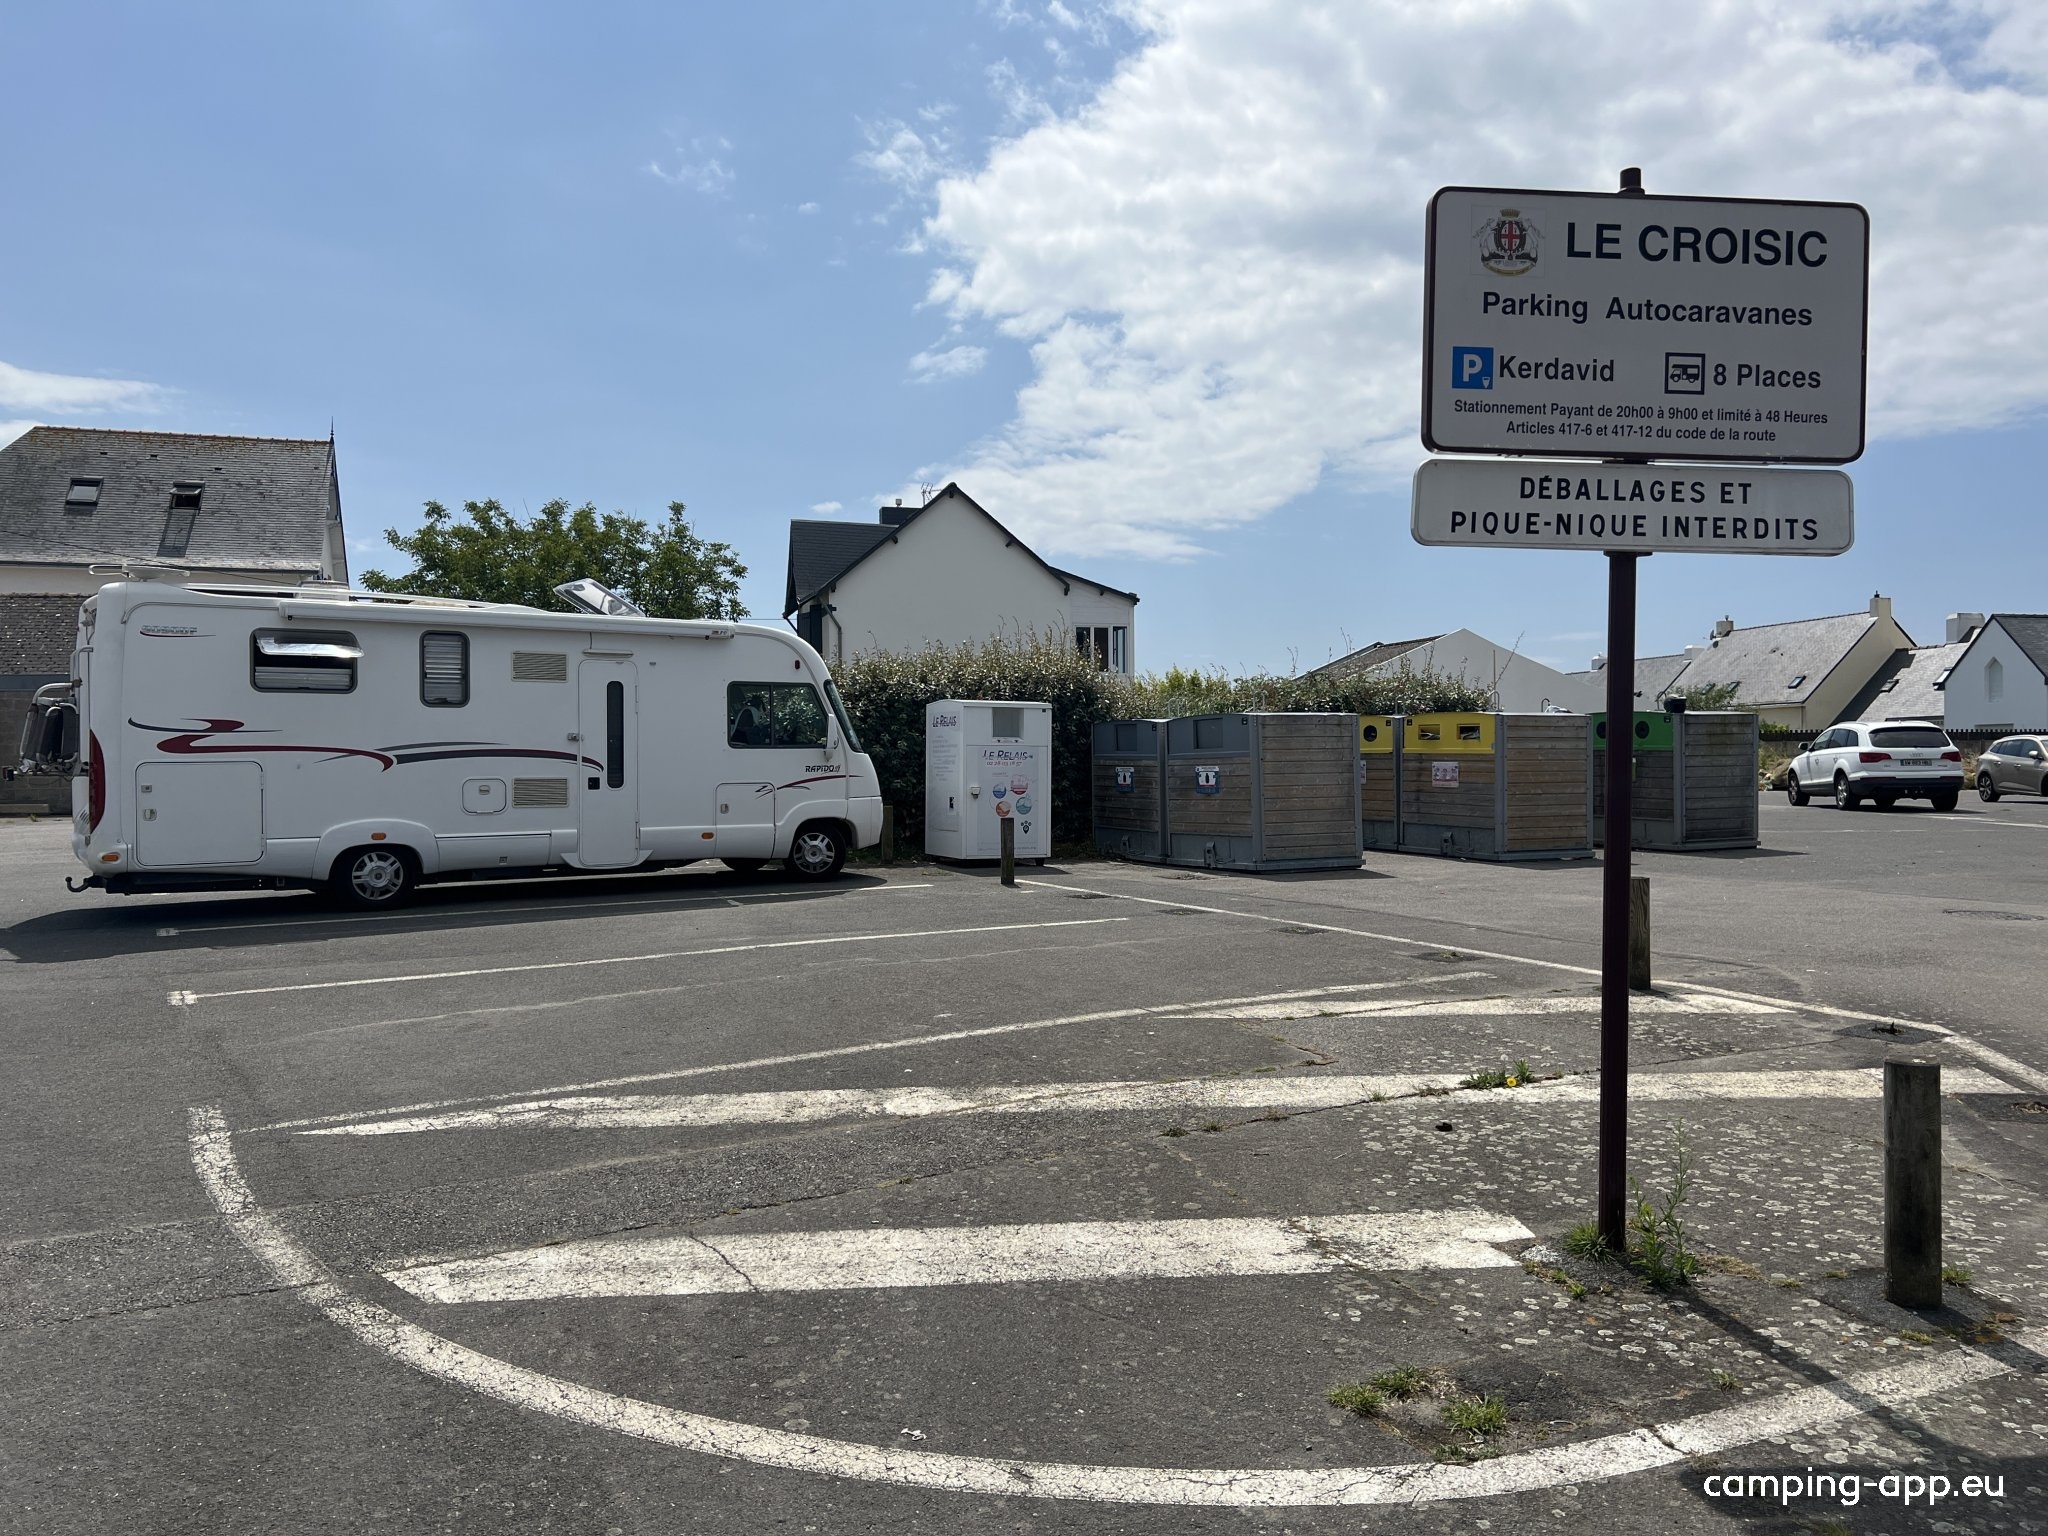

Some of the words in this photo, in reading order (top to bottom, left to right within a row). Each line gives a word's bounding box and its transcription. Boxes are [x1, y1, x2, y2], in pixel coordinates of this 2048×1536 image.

[1567, 222, 1621, 259] LE
[1638, 225, 1827, 267] CROISIC
[1483, 291, 1588, 324] Parking
[1605, 297, 1812, 326] Autocaravanes
[1462, 354, 1482, 382] P
[1499, 355, 1614, 382] Kerdavid
[1713, 363, 1727, 386] 8
[1737, 364, 1821, 389] Places
[1454, 399, 1546, 415] Stationnement
[1551, 402, 1593, 419] Payant
[1597, 405, 1613, 417] de
[1616, 406, 1653, 419] 20h00
[1657, 406, 1664, 419] à
[1668, 407, 1698, 420] 9h00
[1701, 408, 1714, 421] et
[1717, 408, 1751, 421] limité
[1754, 409, 1762, 422] à
[1765, 410, 1780, 423] 48
[1784, 410, 1828, 424] Heures
[1506, 420, 1555, 435] Articles
[1558, 422, 1592, 436] 417-6
[1596, 423, 1608, 436] et
[1611, 424, 1652, 438] 417-12
[1656, 426, 1672, 438] du
[1675, 427, 1706, 440] code
[1709, 428, 1725, 440] de
[1729, 428, 1740, 441] la
[1743, 430, 1776, 442] route
[1520, 475, 1706, 503] DÉBALLAGES
[1720, 482, 1752, 504] ET
[1450, 511, 1647, 538] PIQUE-NIQUE
[1662, 515, 1818, 541] INTERDITS
[983, 749, 995, 760] LE
[996, 750, 1028, 761] RELAIS
[805, 765, 835, 773] RAPIDO
